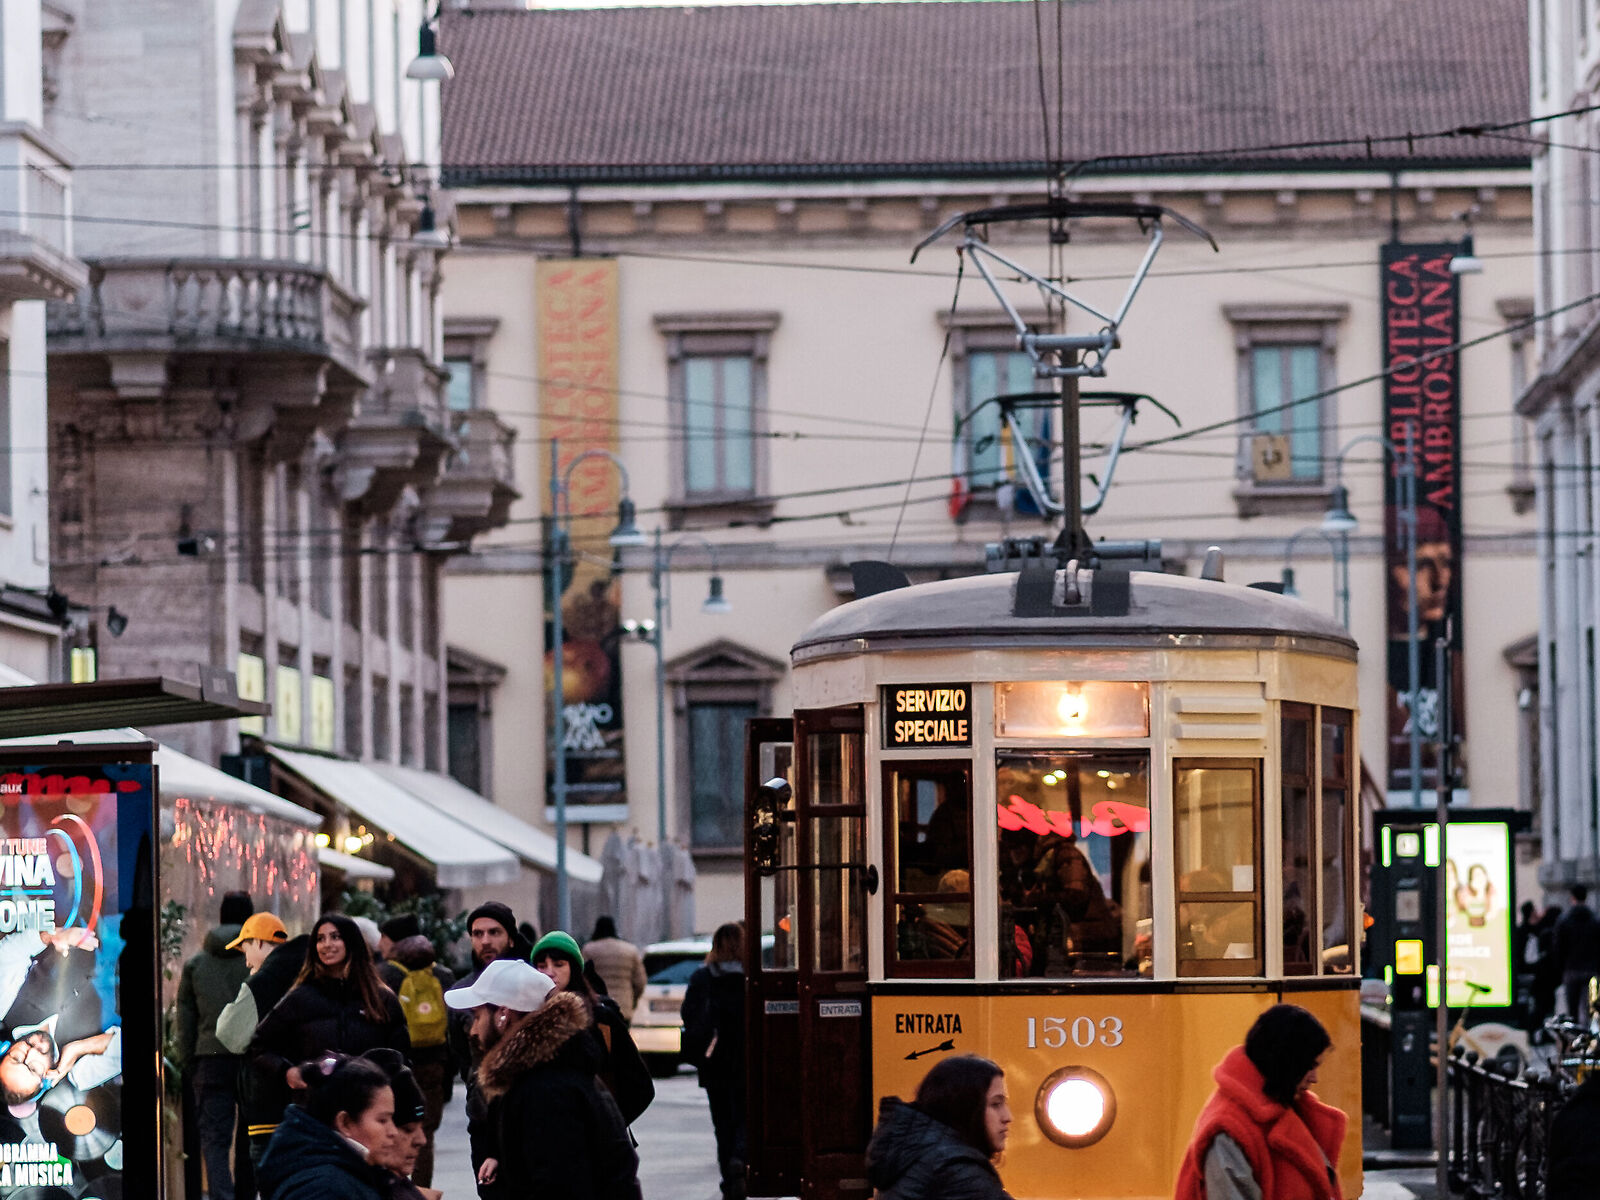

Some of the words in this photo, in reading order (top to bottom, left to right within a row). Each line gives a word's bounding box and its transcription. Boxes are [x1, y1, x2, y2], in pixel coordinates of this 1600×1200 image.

[1421, 253, 1454, 511] AMBROSIANA
[896, 689, 966, 713] SERVIZIO
[894, 719, 968, 742] SPECIALE
[6, 838, 47, 856] TUNE
[767, 1002, 799, 1013] ENTRAT
[821, 1003, 861, 1016] ENTRATA
[895, 1013, 963, 1035] ENTRATA
[1027, 1016, 1123, 1048] 1503
[15, 1163, 73, 1187] MUSICA
